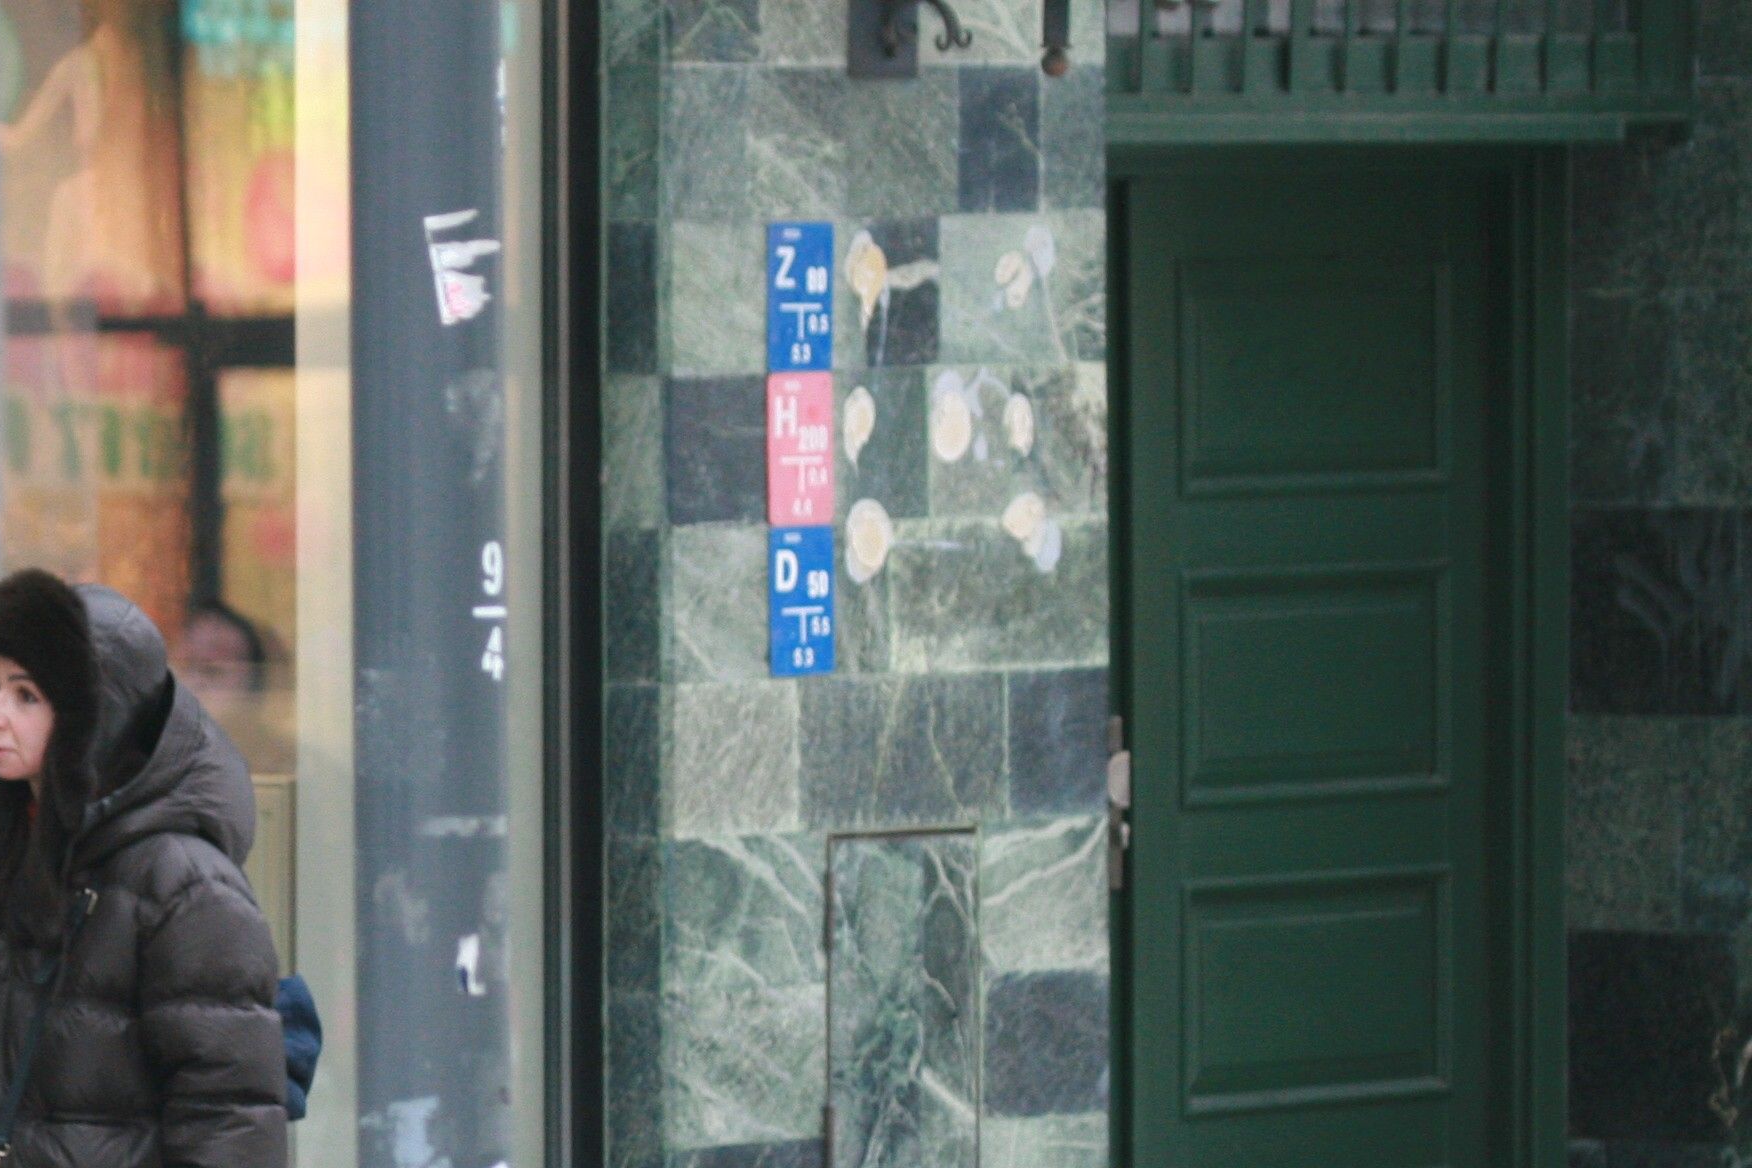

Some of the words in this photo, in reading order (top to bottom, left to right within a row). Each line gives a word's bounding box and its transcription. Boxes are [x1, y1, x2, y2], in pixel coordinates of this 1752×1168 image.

[775, 245, 796, 289] Z
[774, 395, 798, 438] H
[482, 541, 503, 596] 9
[775, 549, 798, 593] D
